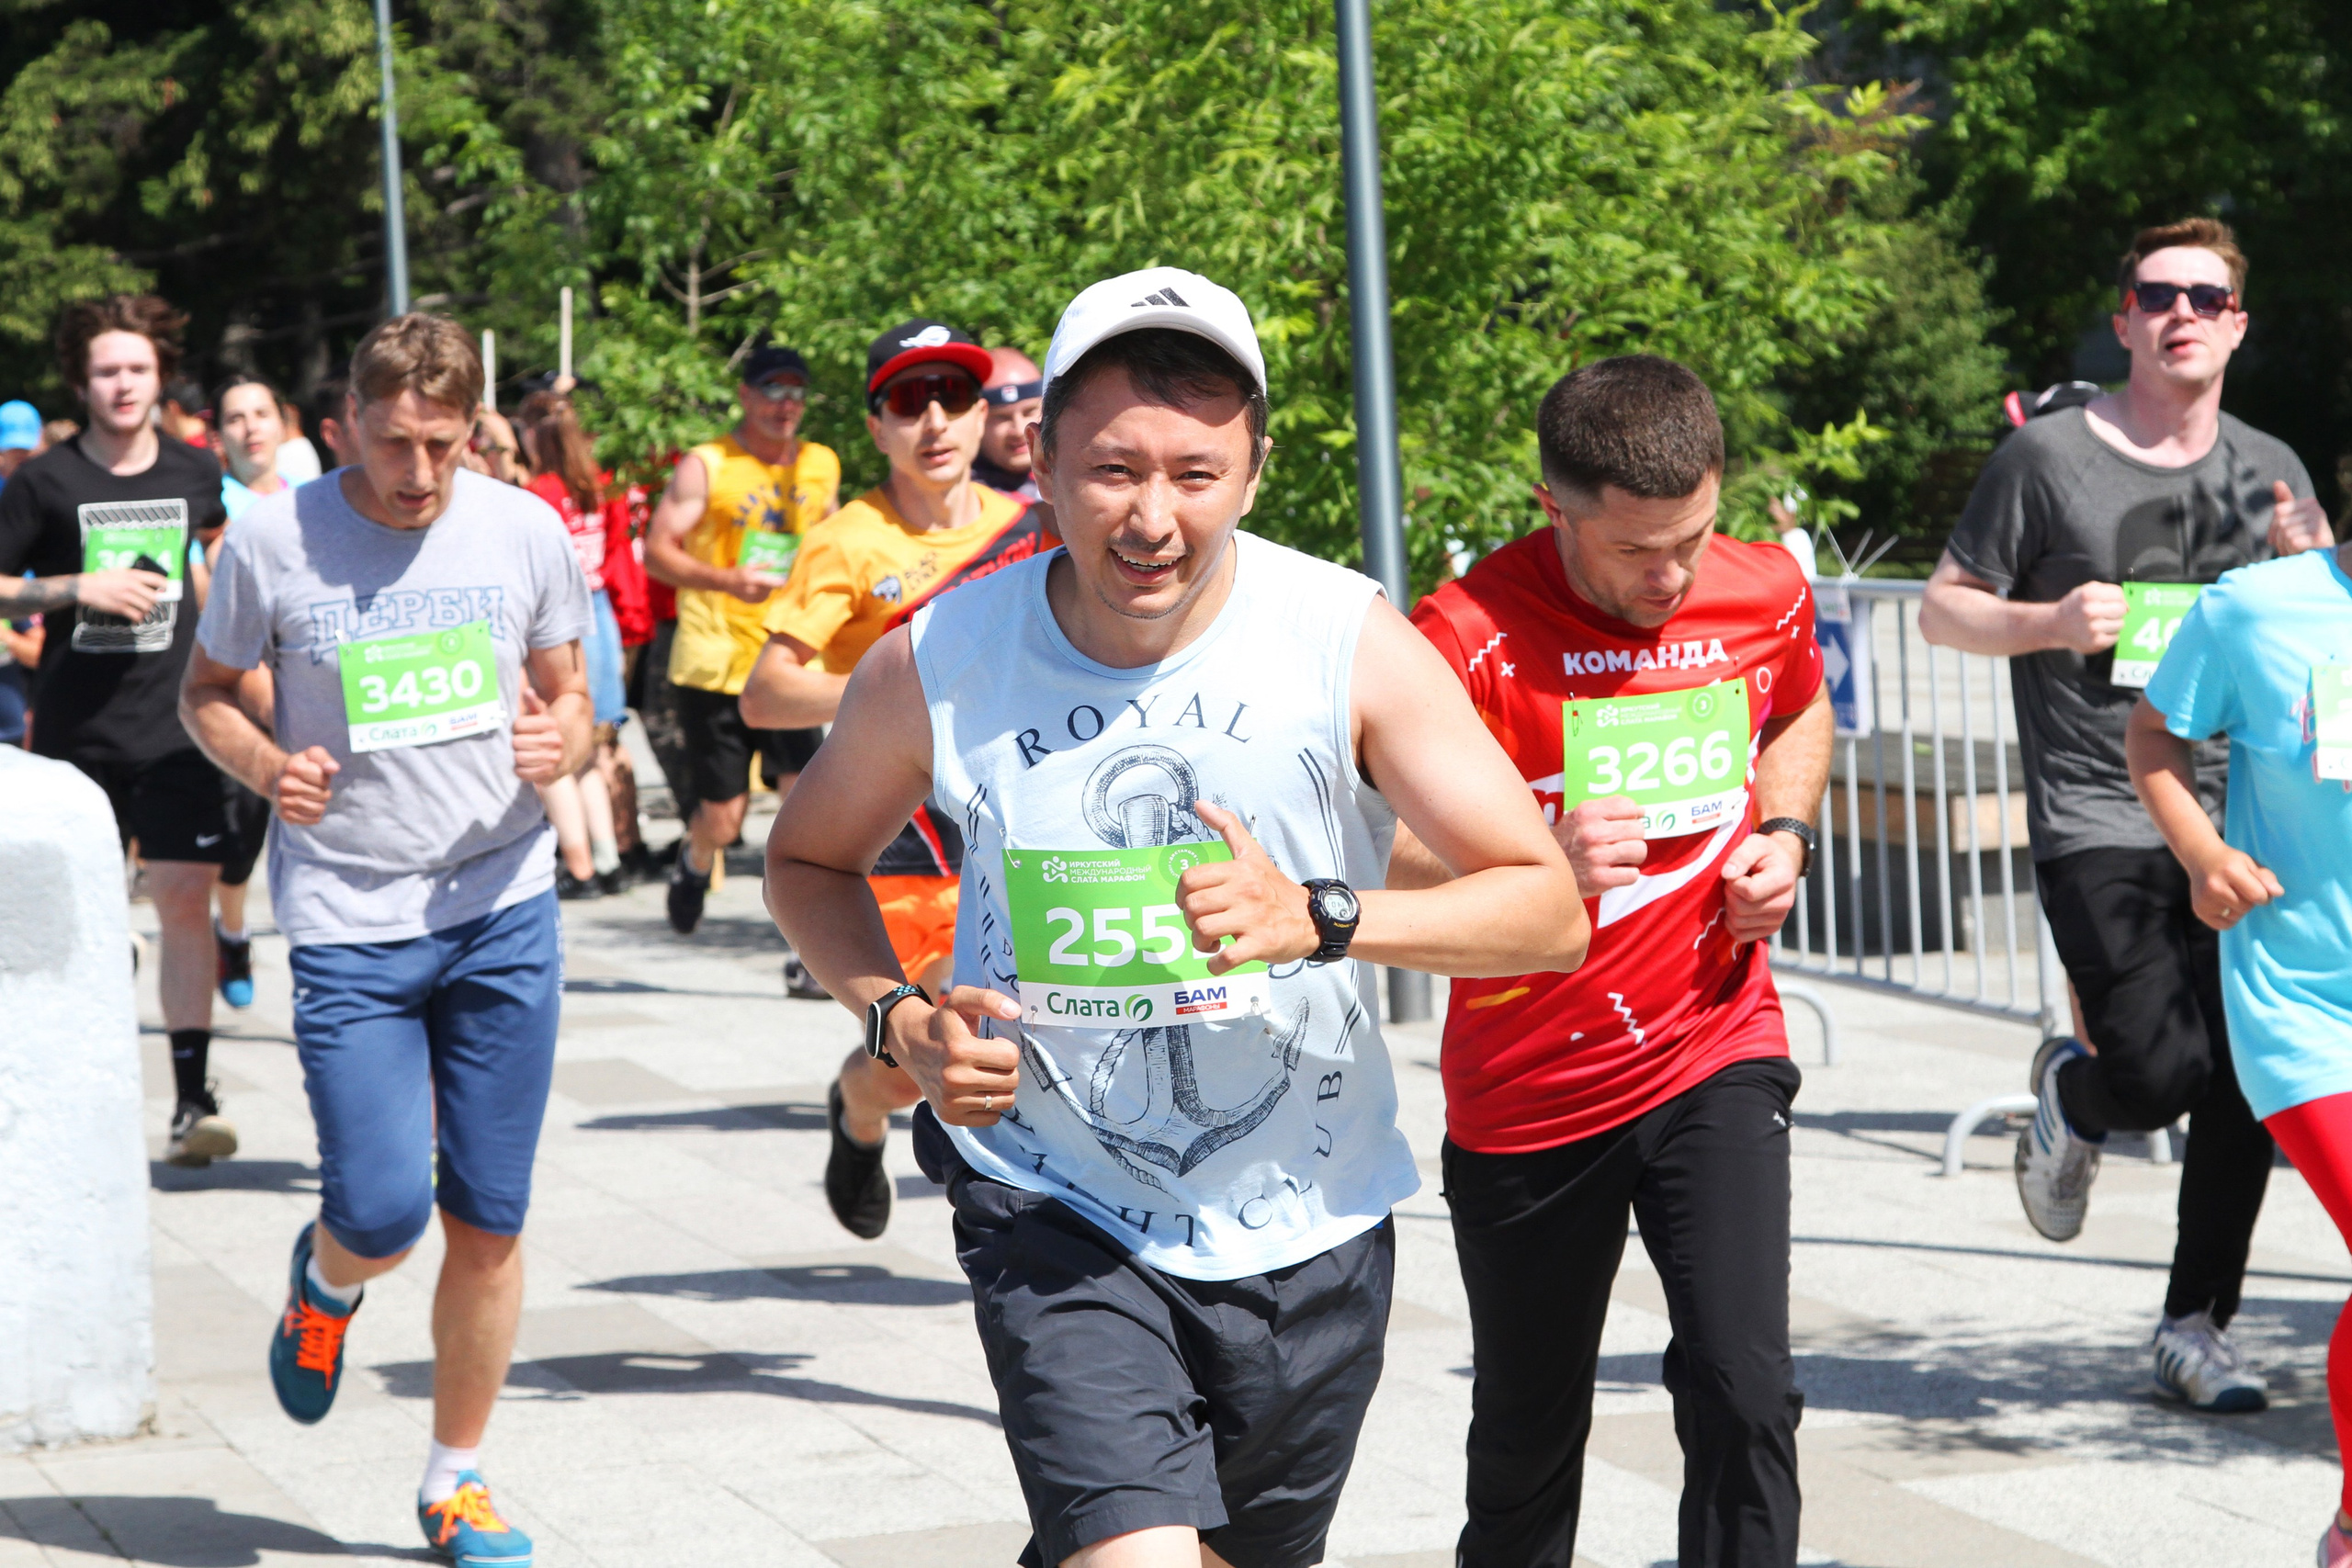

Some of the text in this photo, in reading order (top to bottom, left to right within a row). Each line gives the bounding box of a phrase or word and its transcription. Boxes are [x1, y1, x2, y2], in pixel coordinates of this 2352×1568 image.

[1563, 638, 1729, 676] КОМАНДА
[359, 660, 483, 714] 3430
[1012, 692, 1252, 770] ROYAL
[1588, 730, 1733, 795] 3266
[1691, 800, 1723, 817] БАМ
[1069, 858, 1121, 868] ИРКУТСКИЙ
[1069, 864, 1152, 875] МЕЖДУНАРОДНЫЙ
[1180, 858, 1190, 871] 3
[1071, 874, 1146, 884] СЛАТА МАРАФОН
[1046, 991, 1120, 1018] Слата
[1174, 987, 1227, 1005] БАМ
